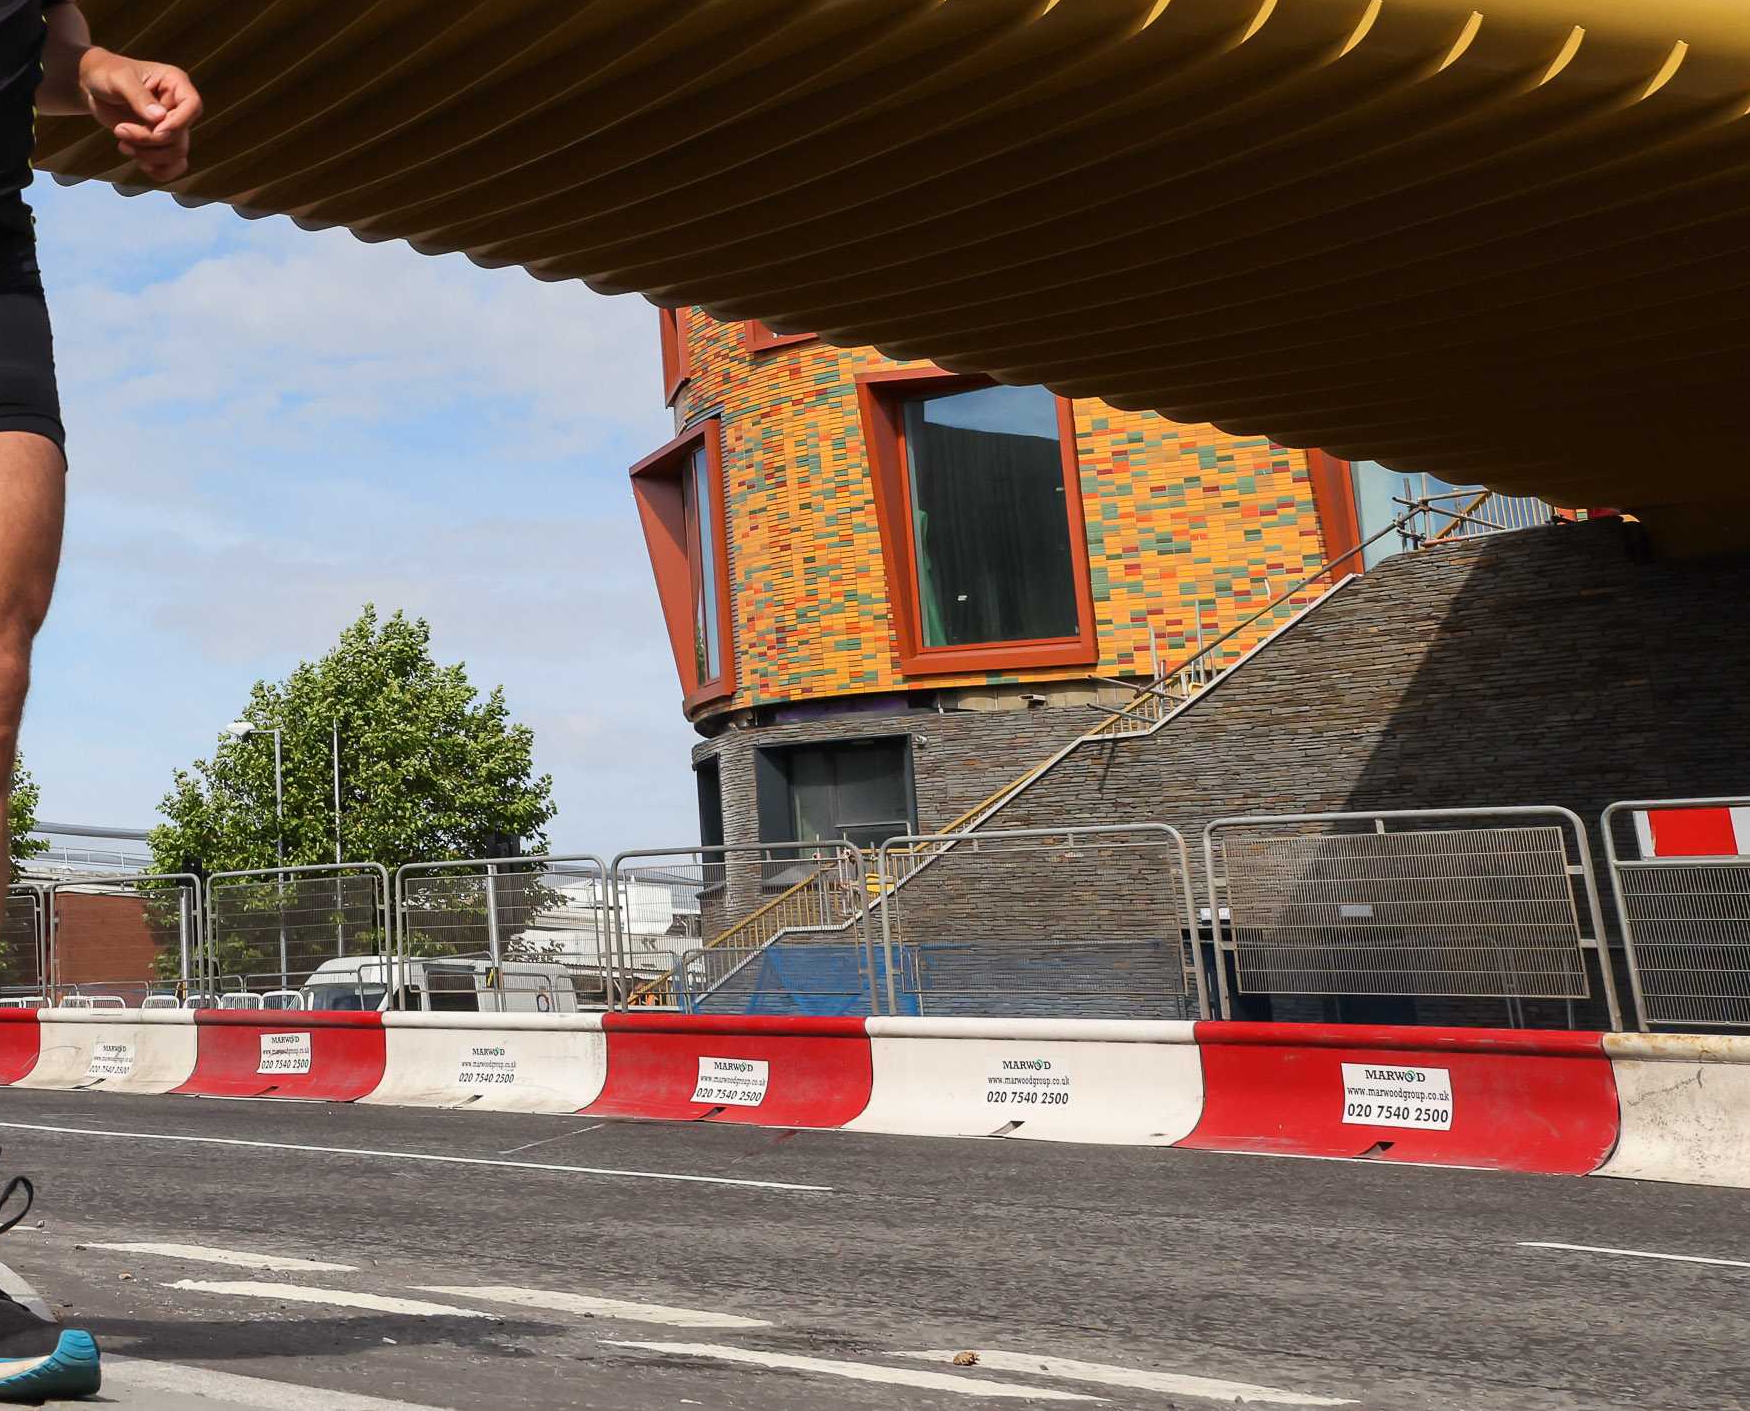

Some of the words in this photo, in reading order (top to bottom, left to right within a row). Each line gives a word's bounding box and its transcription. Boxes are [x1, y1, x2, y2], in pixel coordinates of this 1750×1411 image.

[261, 1060, 273, 1068] 020
[275, 1060, 291, 1068] 7540
[293, 1059, 309, 1068] 2500
[459, 1073, 473, 1082] 020
[475, 1073, 493, 1082] 7540
[495, 1074, 514, 1083] 2500
[988, 1076, 1070, 1087] www.marwoodgroup.co.uk
[697, 1088, 713, 1097] 020
[715, 1089, 737, 1099] 7540
[739, 1091, 761, 1101] 2500
[987, 1091, 1007, 1103] 020
[1011, 1092, 1037, 1103] 7540
[1041, 1093, 1068, 1104] 2500
[1347, 1088, 1449, 1102] www.marwoodgroup.co.uk
[1348, 1103, 1371, 1117] 020
[1377, 1106, 1409, 1120] 7540
[1414, 1108, 1448, 1122] 2500
